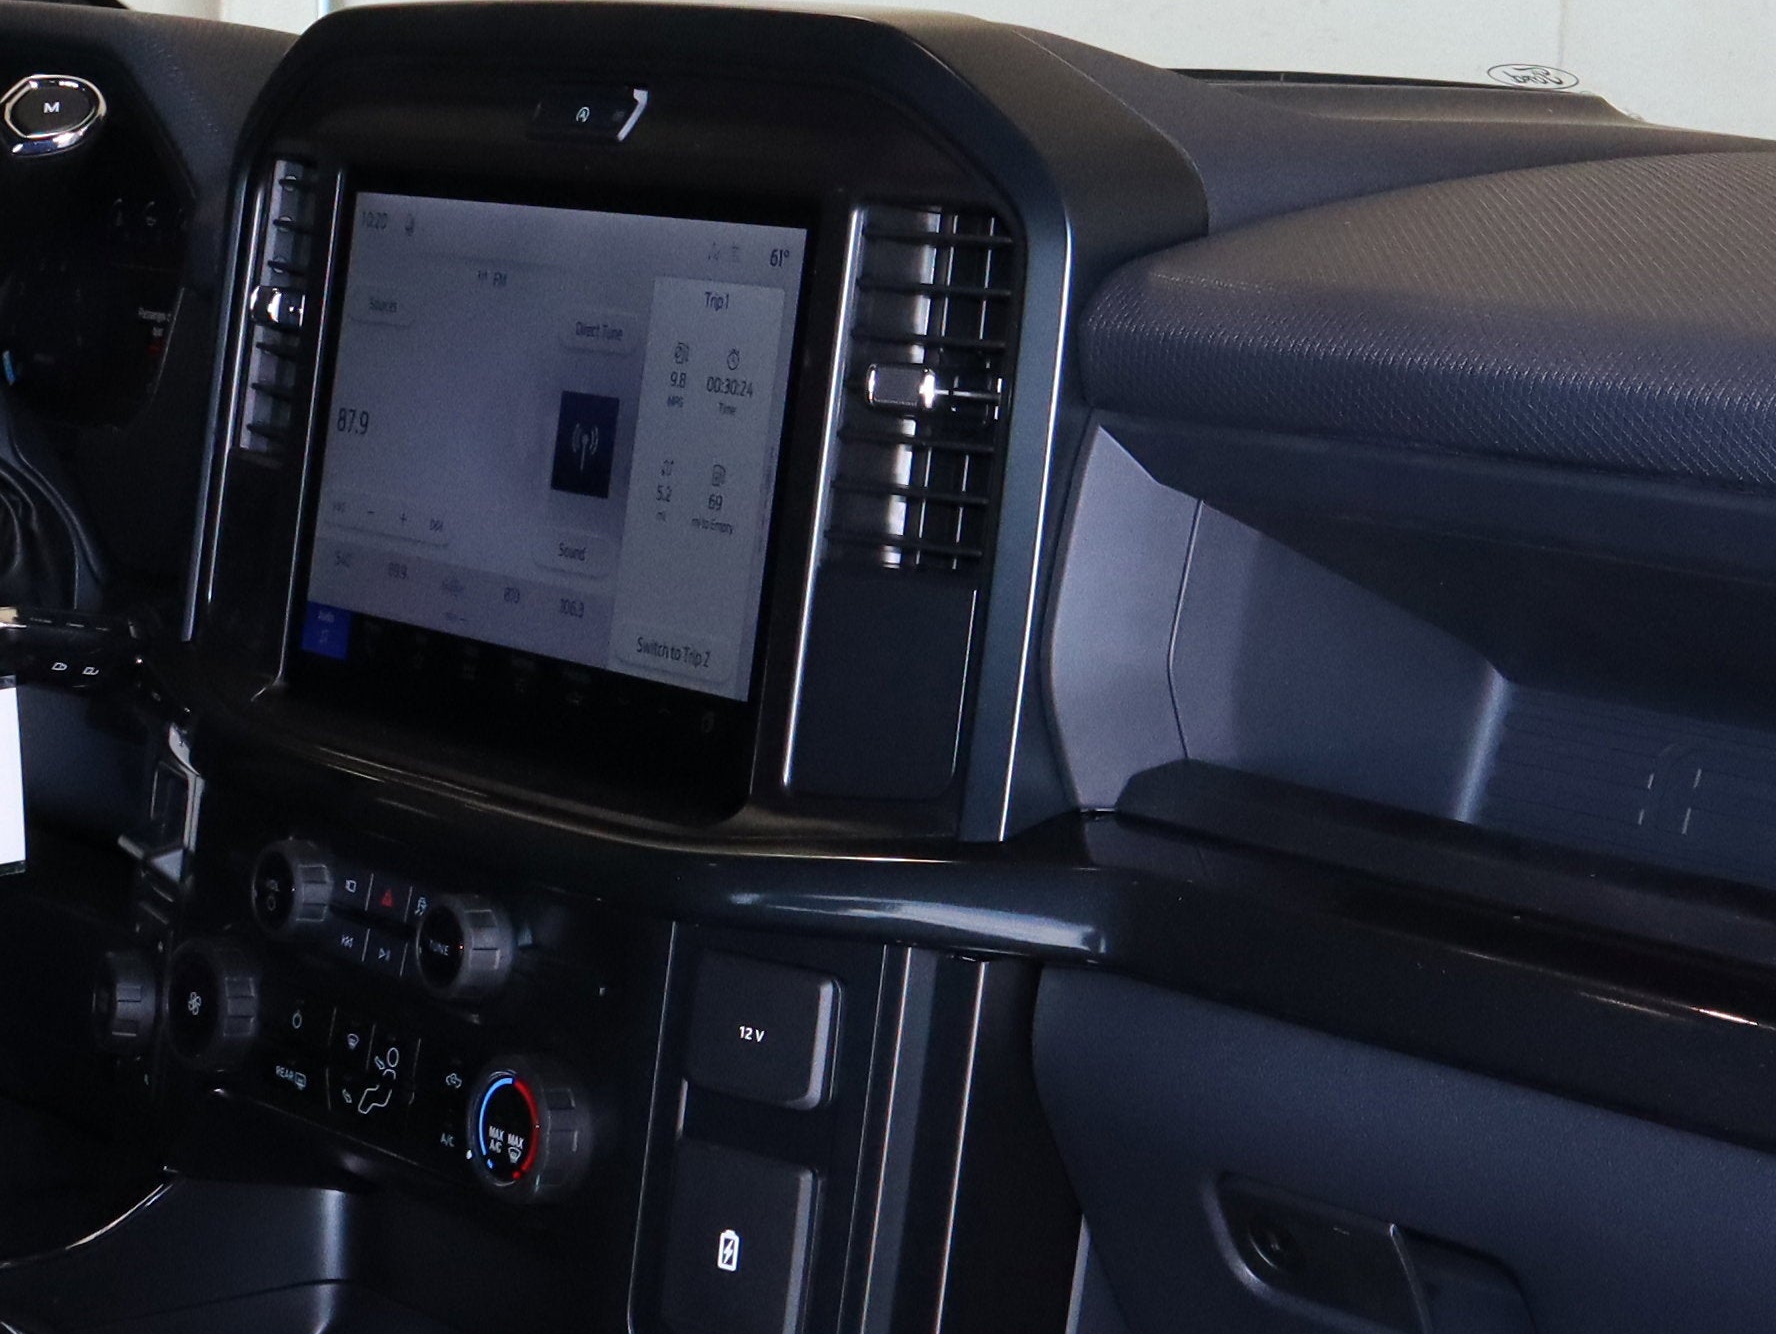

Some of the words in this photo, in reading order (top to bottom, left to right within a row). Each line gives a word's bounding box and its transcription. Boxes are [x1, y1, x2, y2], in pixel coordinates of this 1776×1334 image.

[43, 101, 61, 114] M
[704, 291, 724, 312] Trip
[575, 320, 601, 338] Direct
[603, 324, 624, 341] Tune
[706, 376, 754, 398] 00:30:24
[336, 407, 369, 435] 87.9
[558, 542, 587, 562] Sound
[636, 636, 669, 658] Switch
[683, 646, 701, 669] Trip
[739, 1025, 753, 1041] 12
[755, 1028, 765, 1043] V
[440, 1132, 456, 1148] A/C
[488, 1125, 506, 1140] MAX
[507, 1132, 525, 1150] MAX
[488, 1139, 503, 1154] A/C
